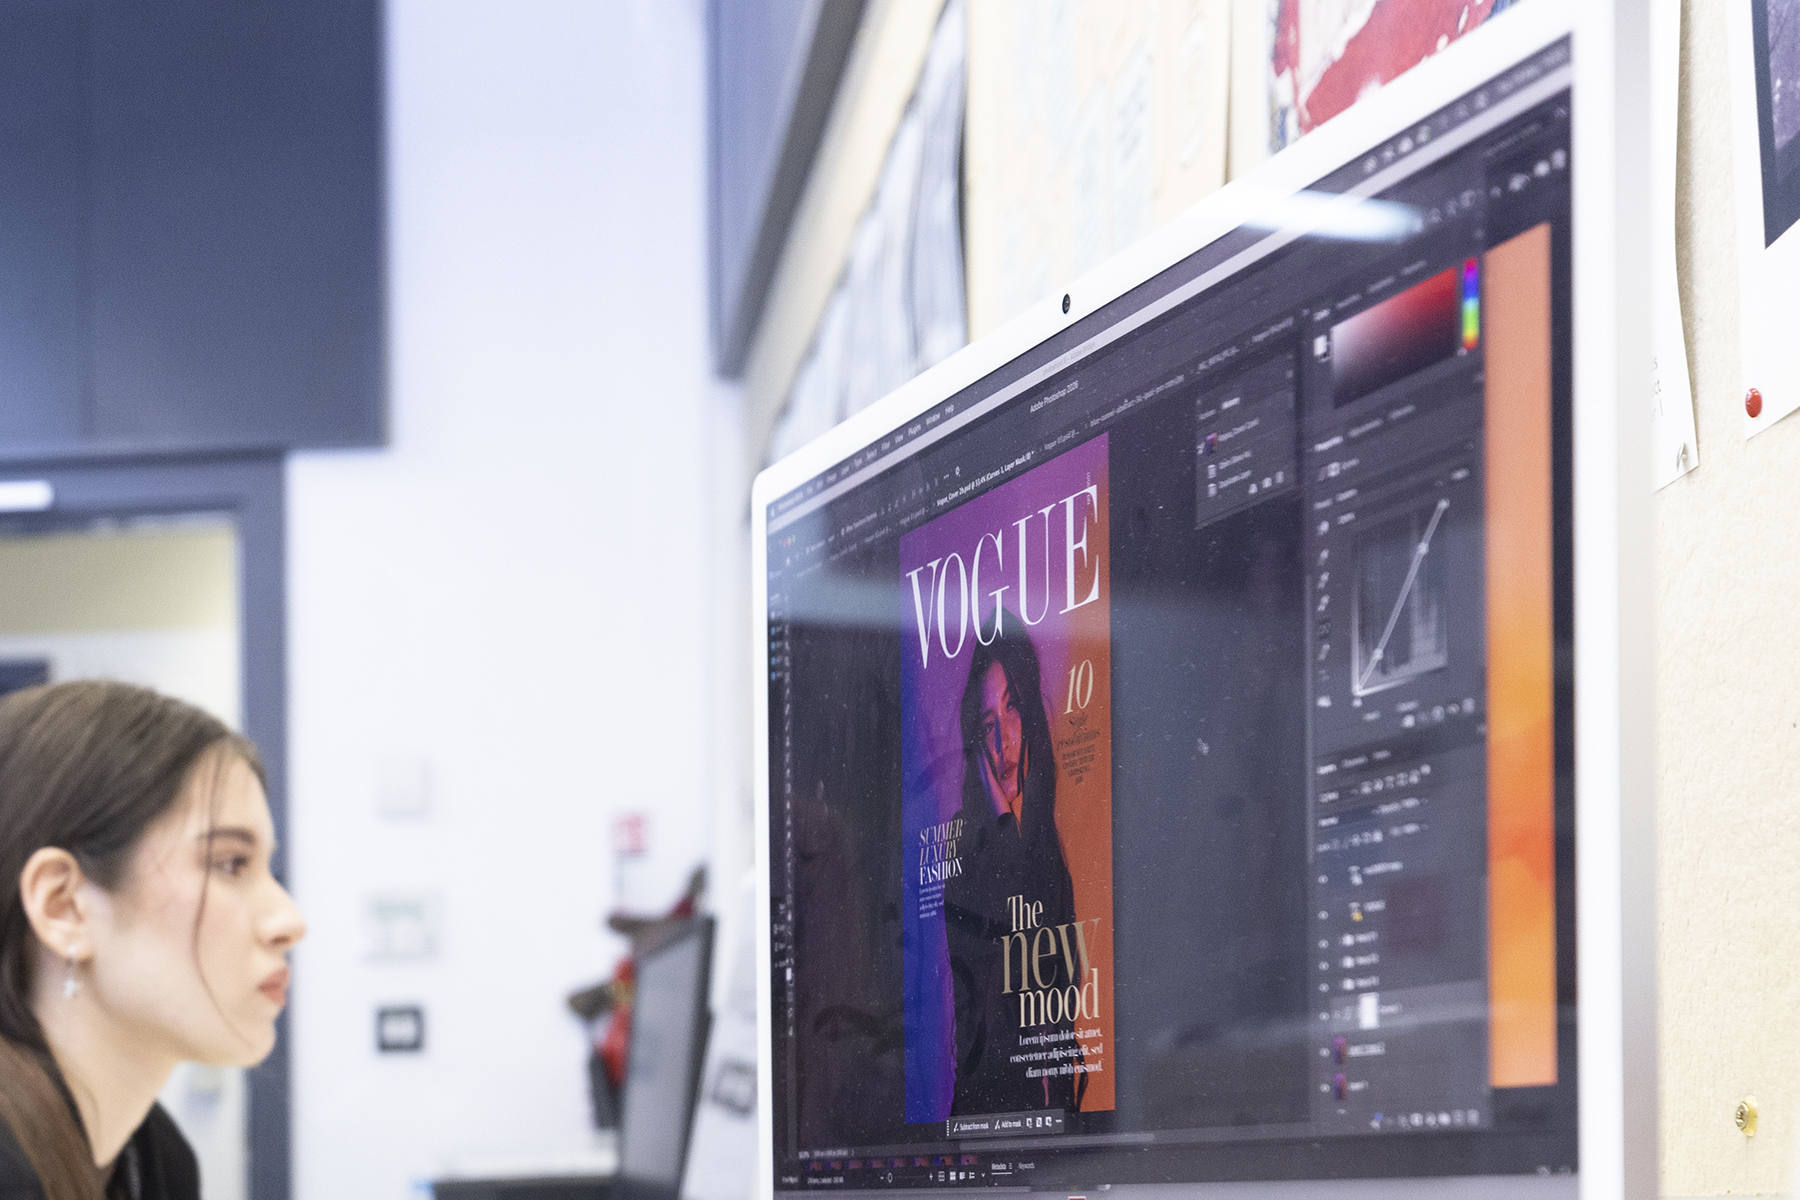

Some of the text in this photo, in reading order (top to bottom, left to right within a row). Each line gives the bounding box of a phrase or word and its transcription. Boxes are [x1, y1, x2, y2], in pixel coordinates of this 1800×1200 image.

[906, 484, 1099, 669] VOGUE
[1063, 659, 1093, 714] 10
[920, 819, 964, 846] SUMMER
[920, 840, 958, 866] LUXURY
[920, 857, 963, 886] FASHION
[1007, 895, 1043, 932] The
[1001, 918, 1101, 994] new
[1019, 968, 1100, 1027] mood
[1020, 1035, 1039, 1046] Lorem
[1040, 1033, 1058, 1046] ipsum
[1059, 1030, 1075, 1041] dolor
[1026, 1067, 1041, 1078] diam
